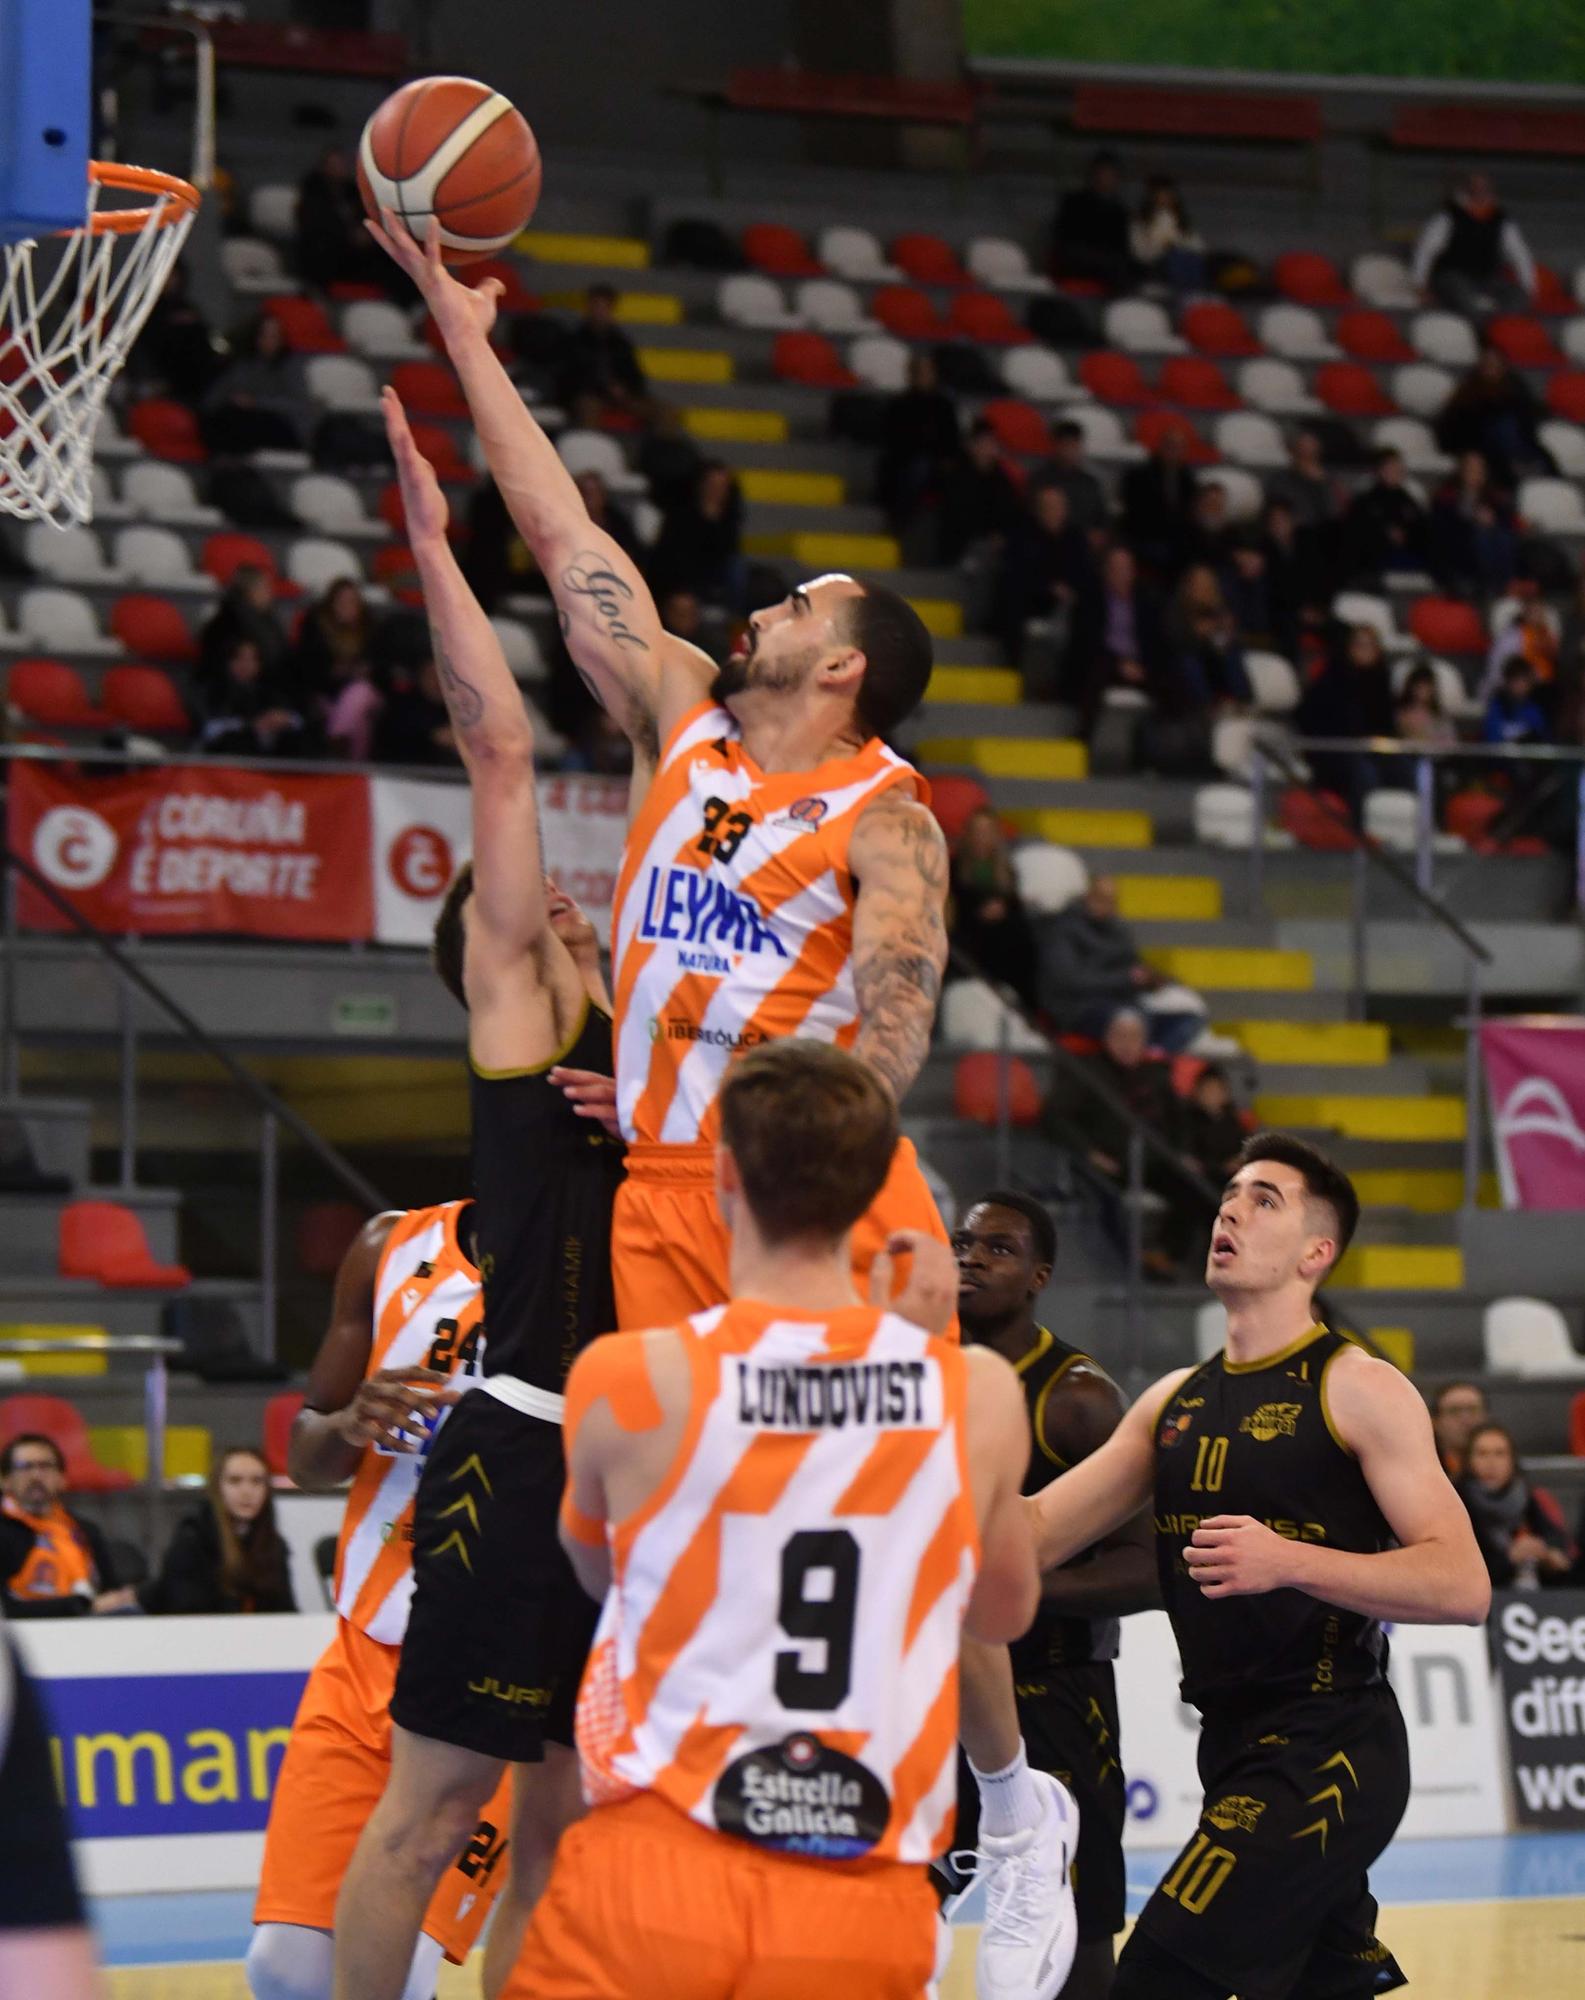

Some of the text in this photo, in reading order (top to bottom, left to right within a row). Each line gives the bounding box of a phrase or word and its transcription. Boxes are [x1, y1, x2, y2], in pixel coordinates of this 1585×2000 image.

[697, 796, 752, 866] 23
[156, 846, 321, 900] DEPORTE
[641, 866, 788, 958] LEYMA
[677, 950, 731, 973] NATURA
[429, 1318, 485, 1376] 24
[738, 1361, 925, 1428] LUNDQVIST
[1189, 1435, 1230, 1492] 10
[773, 1530, 861, 1712] 9
[742, 1764, 862, 1807] Estrella
[744, 1799, 859, 1836] Galicia
[1160, 1831, 1238, 1915] 10
